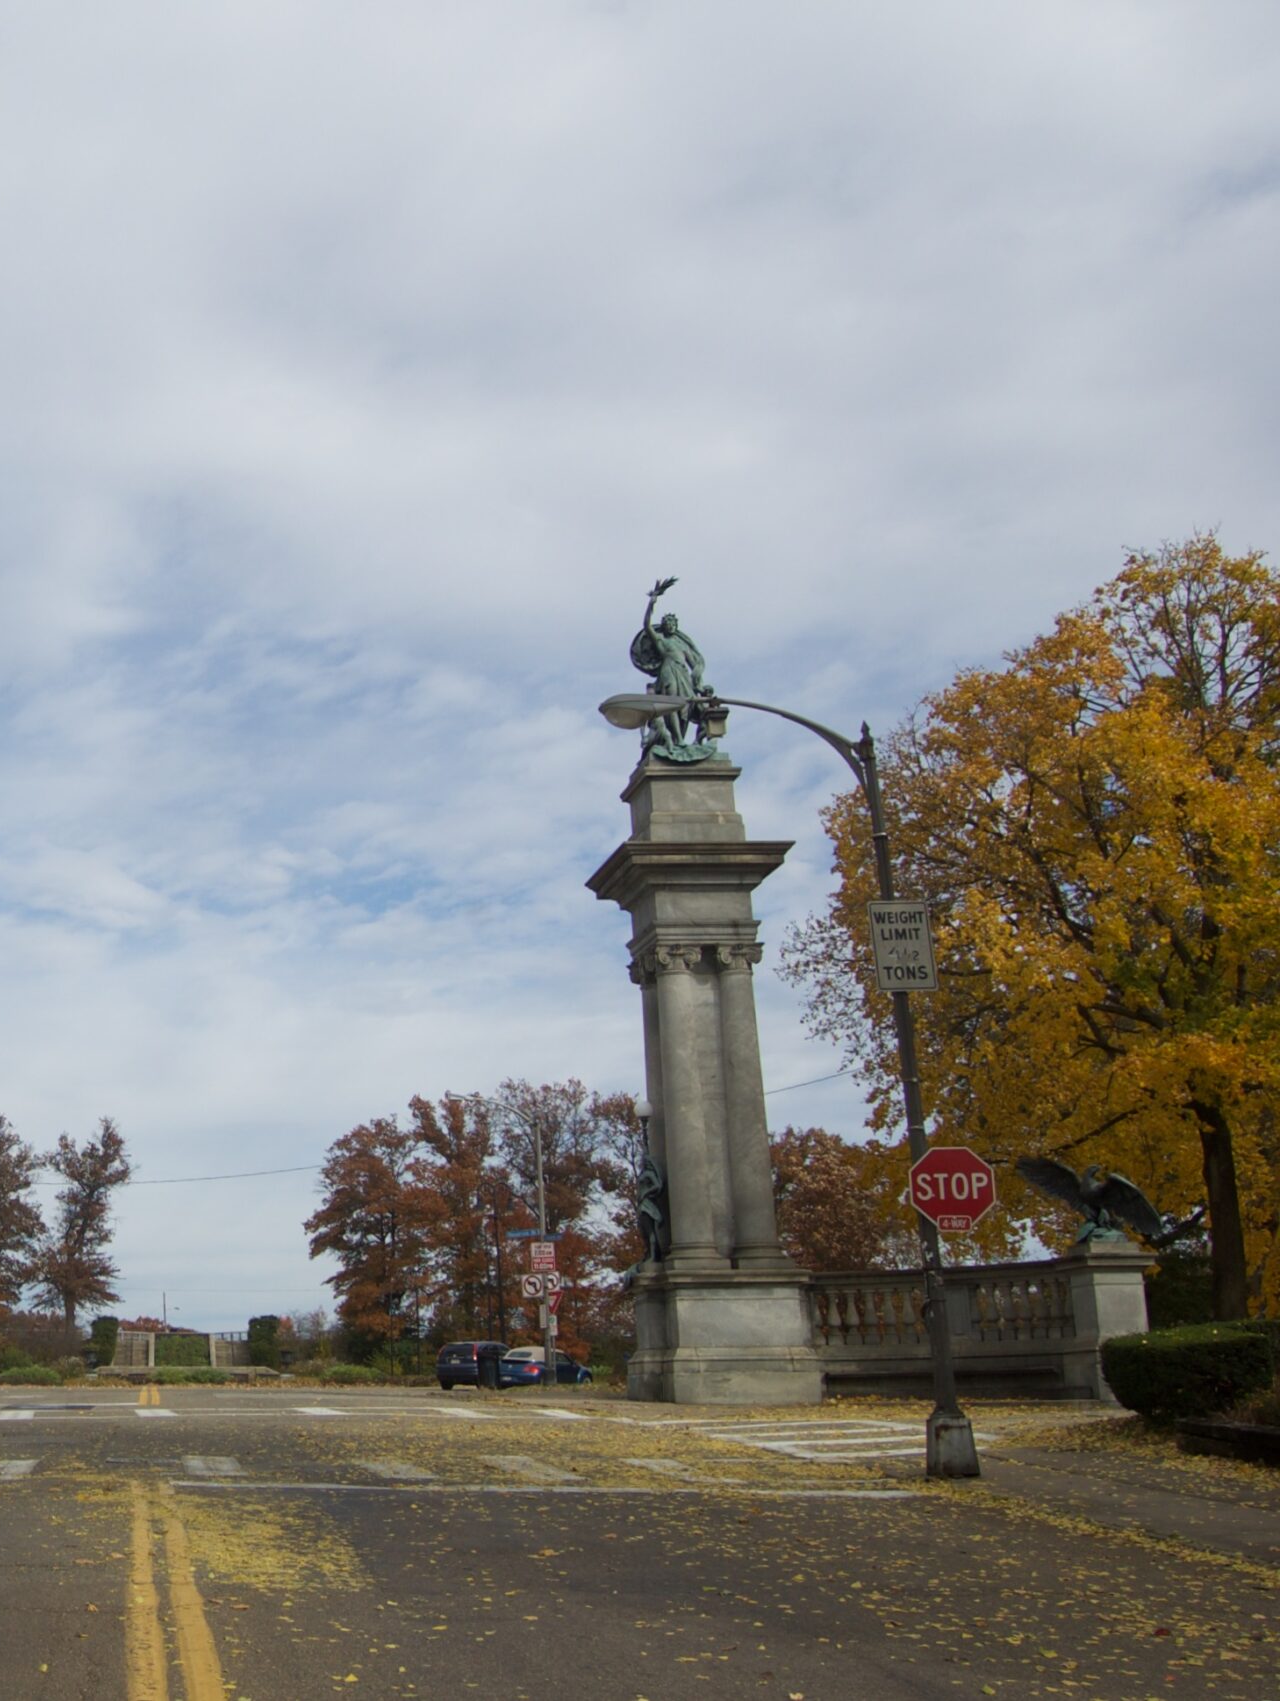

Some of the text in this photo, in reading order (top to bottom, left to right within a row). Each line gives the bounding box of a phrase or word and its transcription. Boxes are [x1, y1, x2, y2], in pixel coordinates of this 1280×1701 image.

[873, 911, 924, 924] WEIGHT
[880, 927, 920, 941] LIMIT
[883, 965, 928, 980] TONS
[916, 1172, 988, 1201] STOP
[942, 1218, 968, 1229] 4-WAY
